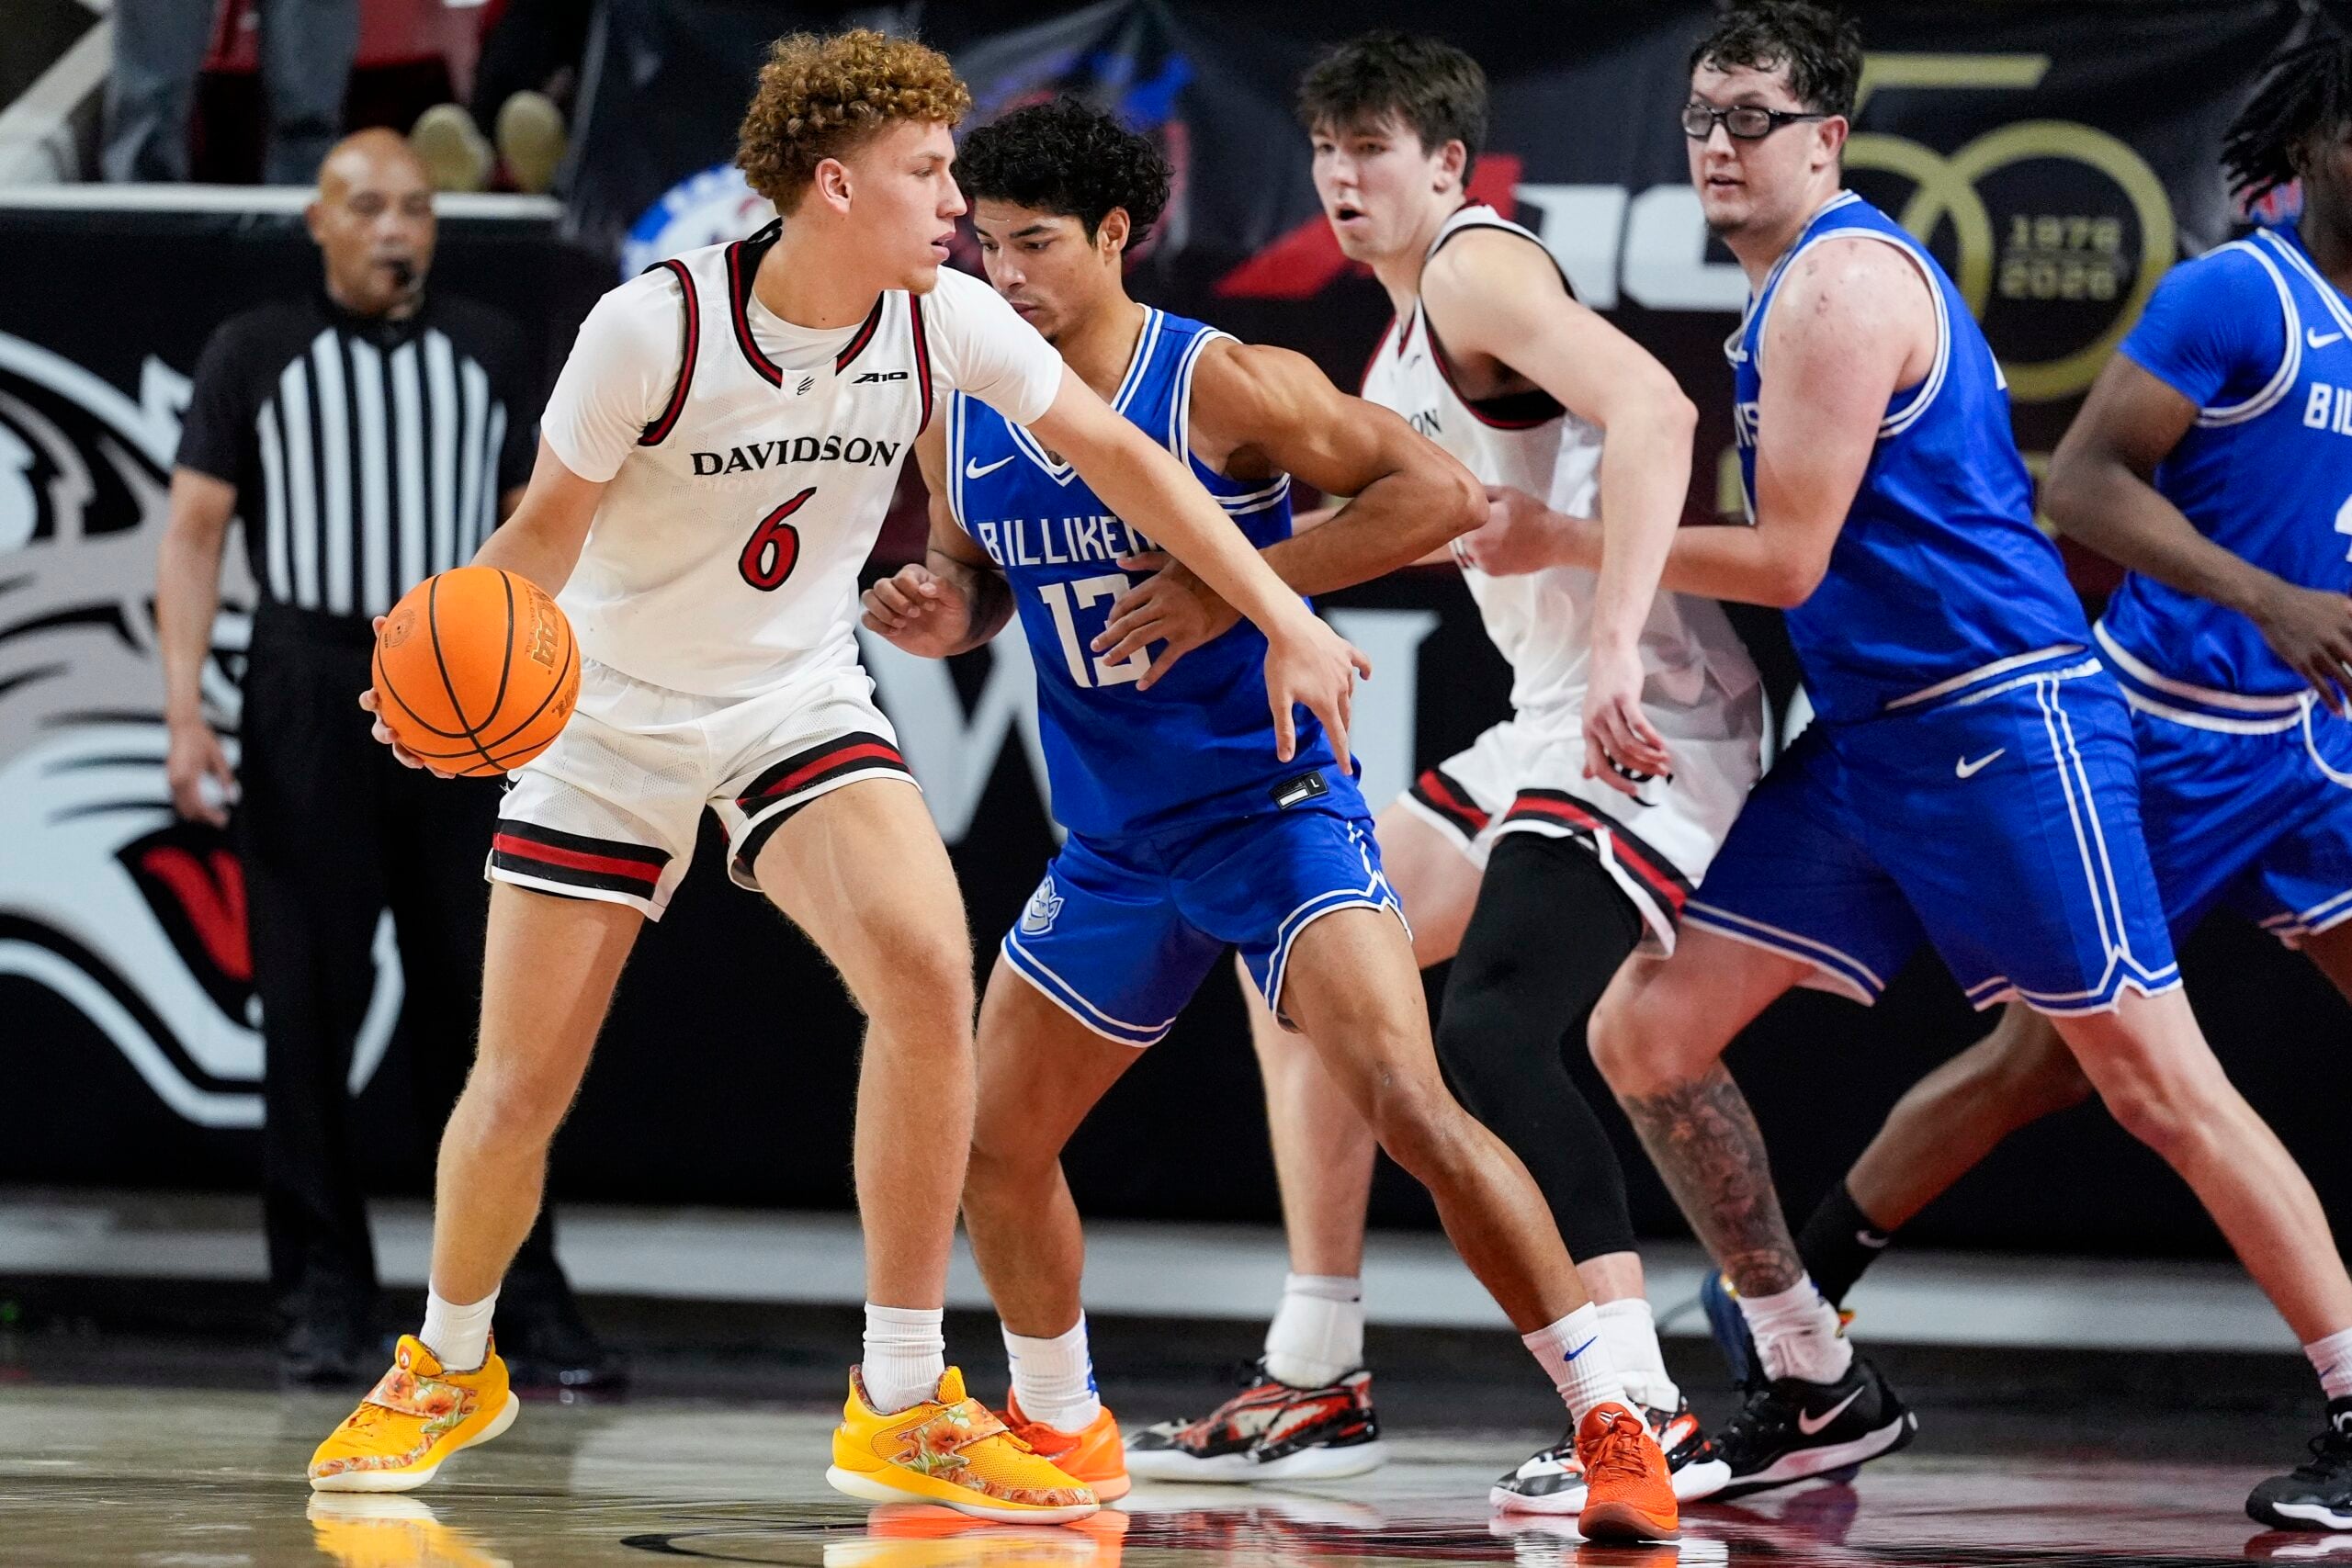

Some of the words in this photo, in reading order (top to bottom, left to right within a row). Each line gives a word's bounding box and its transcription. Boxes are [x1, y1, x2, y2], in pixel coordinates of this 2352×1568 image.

[851, 371, 909, 385] A10
[690, 435, 901, 476] DAVIDSON
[738, 486, 818, 592] 6
